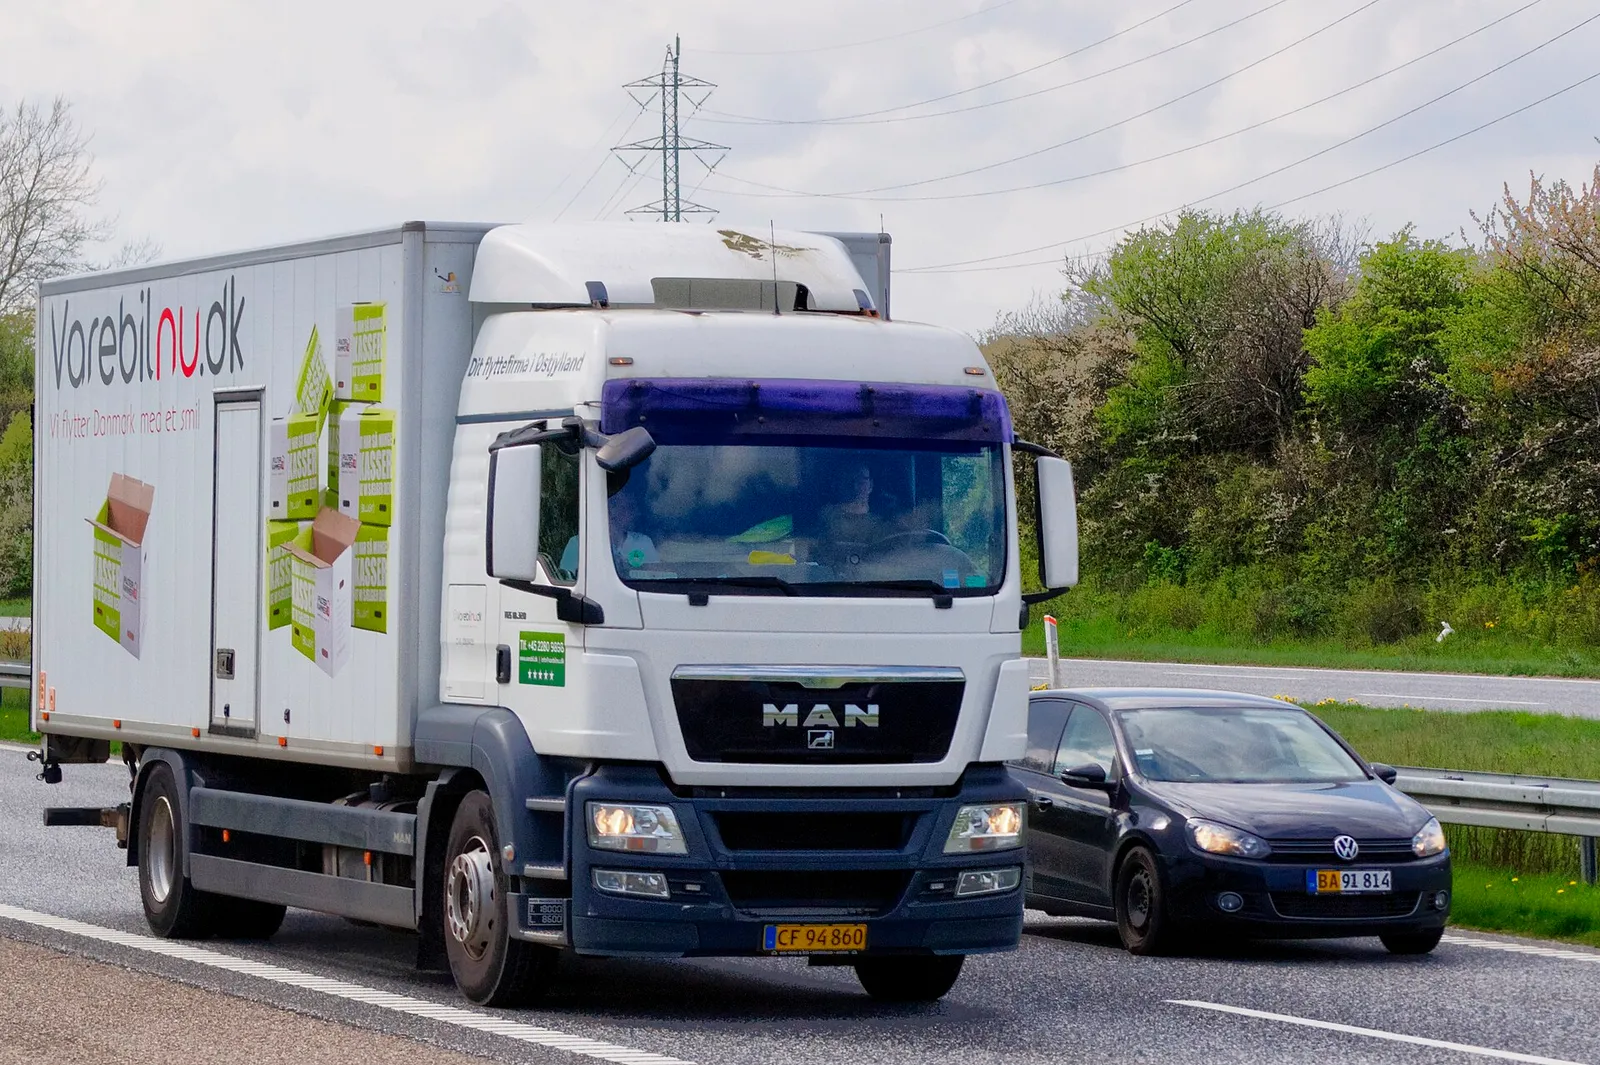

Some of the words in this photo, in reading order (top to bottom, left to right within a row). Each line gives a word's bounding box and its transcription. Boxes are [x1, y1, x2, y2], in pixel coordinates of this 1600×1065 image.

[51, 274, 245, 390] Varebilnu.dk
[467, 357, 484, 377] Dit
[482, 354, 530, 380] flyttefirma
[529, 353, 537, 373] i
[535, 351, 586, 377] Østjylland
[50, 412, 59, 439] Vi
[62, 408, 91, 445] flytter
[93, 403, 135, 437] Danmark
[140, 403, 162, 434] med
[165, 405, 177, 432] et
[180, 398, 200, 431] smil
[762, 703, 880, 727] MAN
[393, 832, 412, 845] MAN
[1318, 873, 1339, 889] BA
[1342, 873, 1358, 889] 91
[1363, 872, 1390, 889] 814
[778, 929, 800, 946] CF
